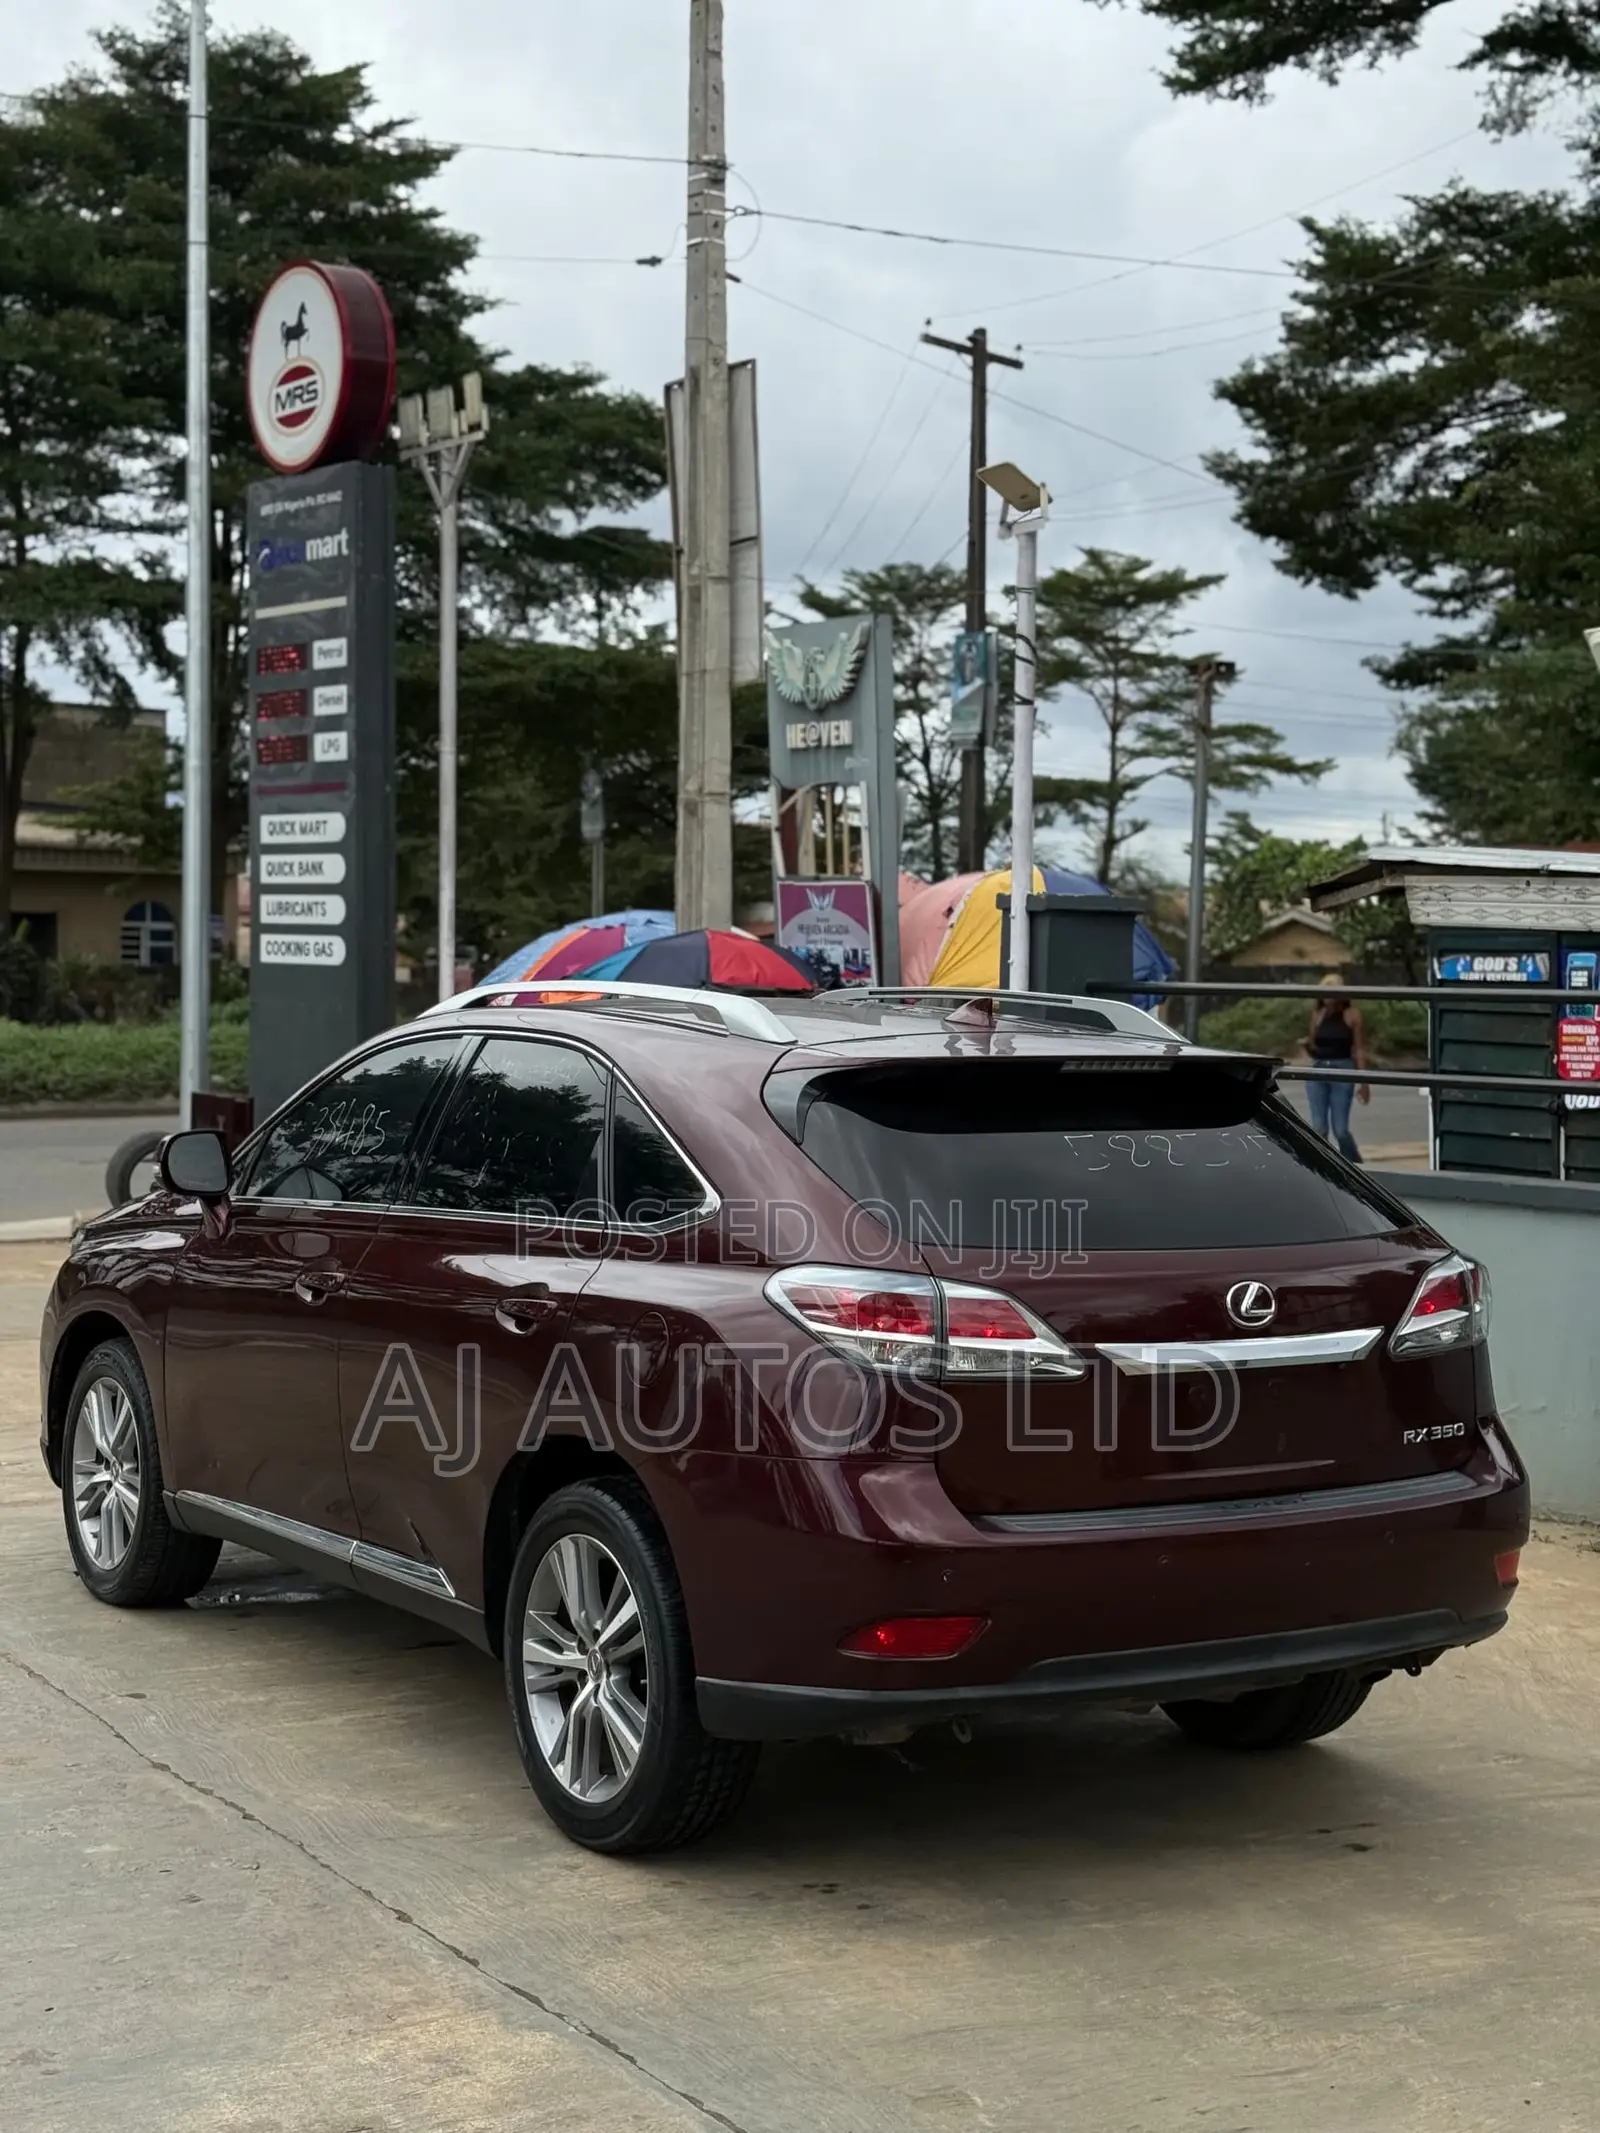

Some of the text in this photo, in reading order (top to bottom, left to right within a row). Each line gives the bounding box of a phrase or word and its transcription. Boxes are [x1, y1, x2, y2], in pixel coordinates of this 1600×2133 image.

[275, 380, 319, 413] MRS
[305, 527, 349, 562] mart
[317, 644, 343, 661] Petrol
[318, 692, 344, 707] Diesel
[786, 720, 852, 749] HE@VEN
[321, 738, 340, 754] LPG
[267, 820, 328, 836] QUICK MART
[266, 861, 325, 877] QUICK BANK
[266, 901, 327, 917] LUBRICANTS
[265, 940, 333, 957] COOKING GAS
[1472, 956, 1519, 972] GOD'S
[1403, 1422, 1465, 1445] RX 350
